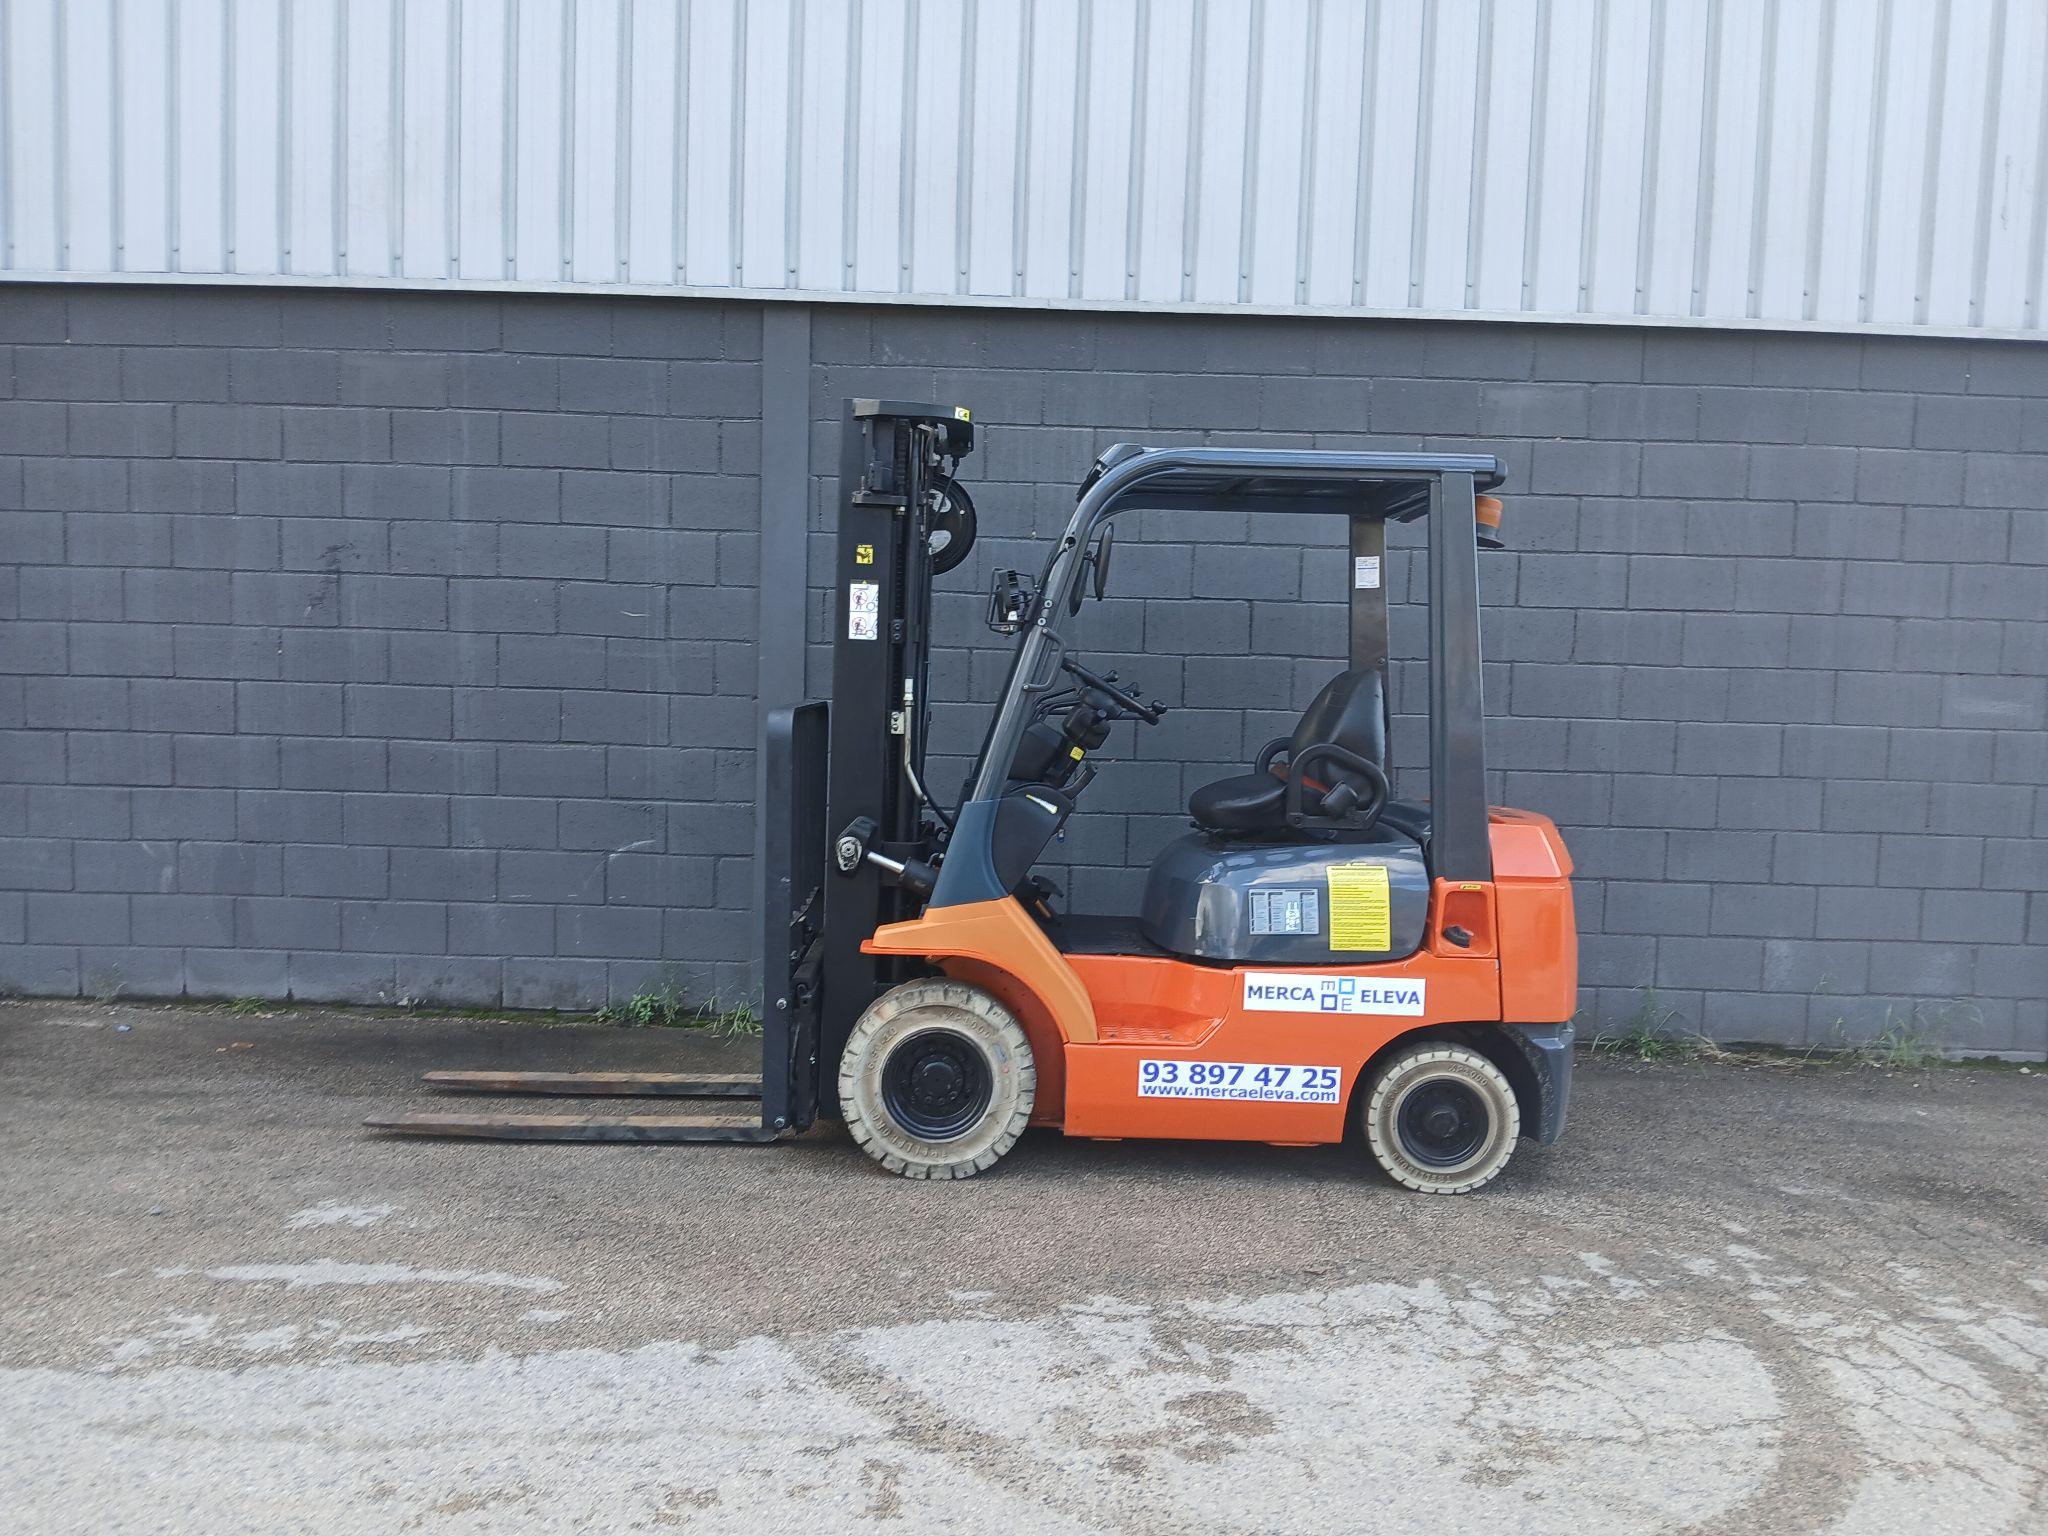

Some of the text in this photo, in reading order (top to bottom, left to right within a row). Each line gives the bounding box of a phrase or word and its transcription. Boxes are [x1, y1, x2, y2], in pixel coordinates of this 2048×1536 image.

[1247, 985, 1420, 1004] MERCA ELEVA
[1142, 1062, 1337, 1089] 93 897 47 25
[1142, 1085, 1336, 1101] www.mercaeleva.com
